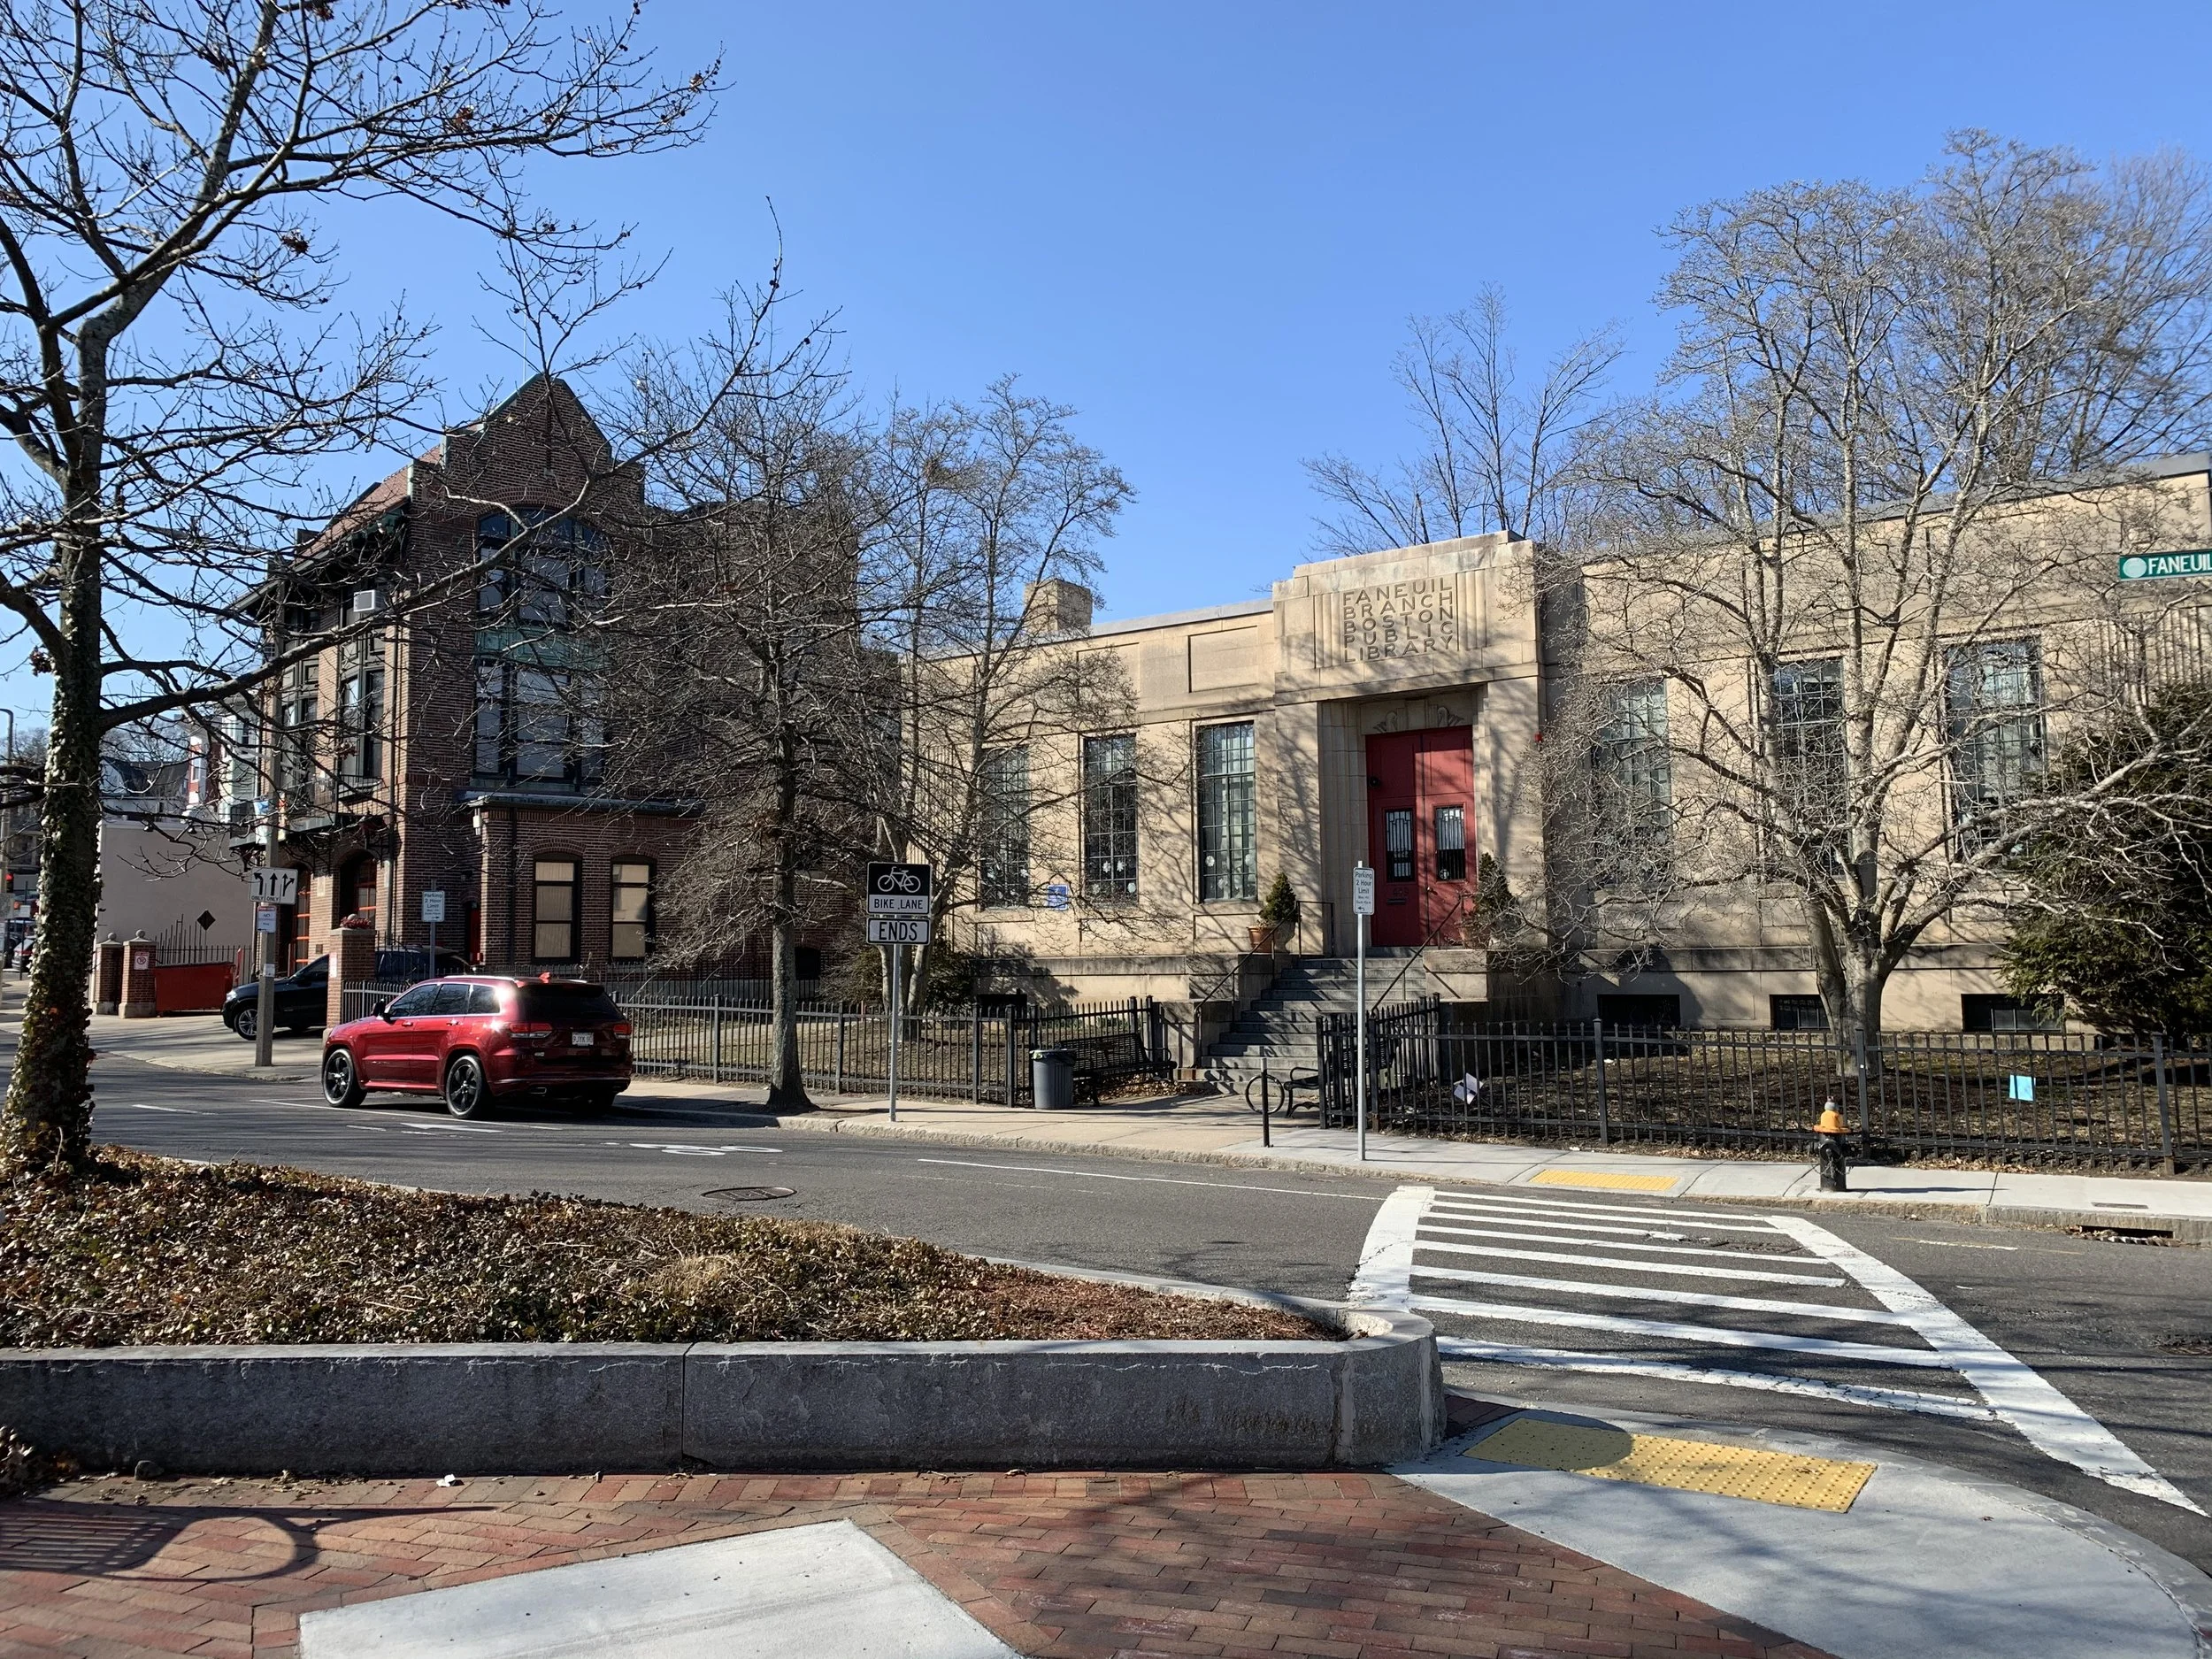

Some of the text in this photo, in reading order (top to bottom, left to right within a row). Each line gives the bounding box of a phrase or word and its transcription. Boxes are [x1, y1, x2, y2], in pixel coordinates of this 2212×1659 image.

[2148, 555, 2212, 574] FANEUIL
[1343, 577, 1453, 606] FANEUIL
[1343, 591, 1453, 620] BRANCH
[1343, 605, 1454, 634] BOSTON
[1344, 620, 1454, 649] PUBLIC
[1344, 634, 1454, 663] LIBRARY
[1355, 871, 1372, 879] Parking
[874, 898, 923, 910] BIKE LANE
[879, 921, 918, 941] ENDS
